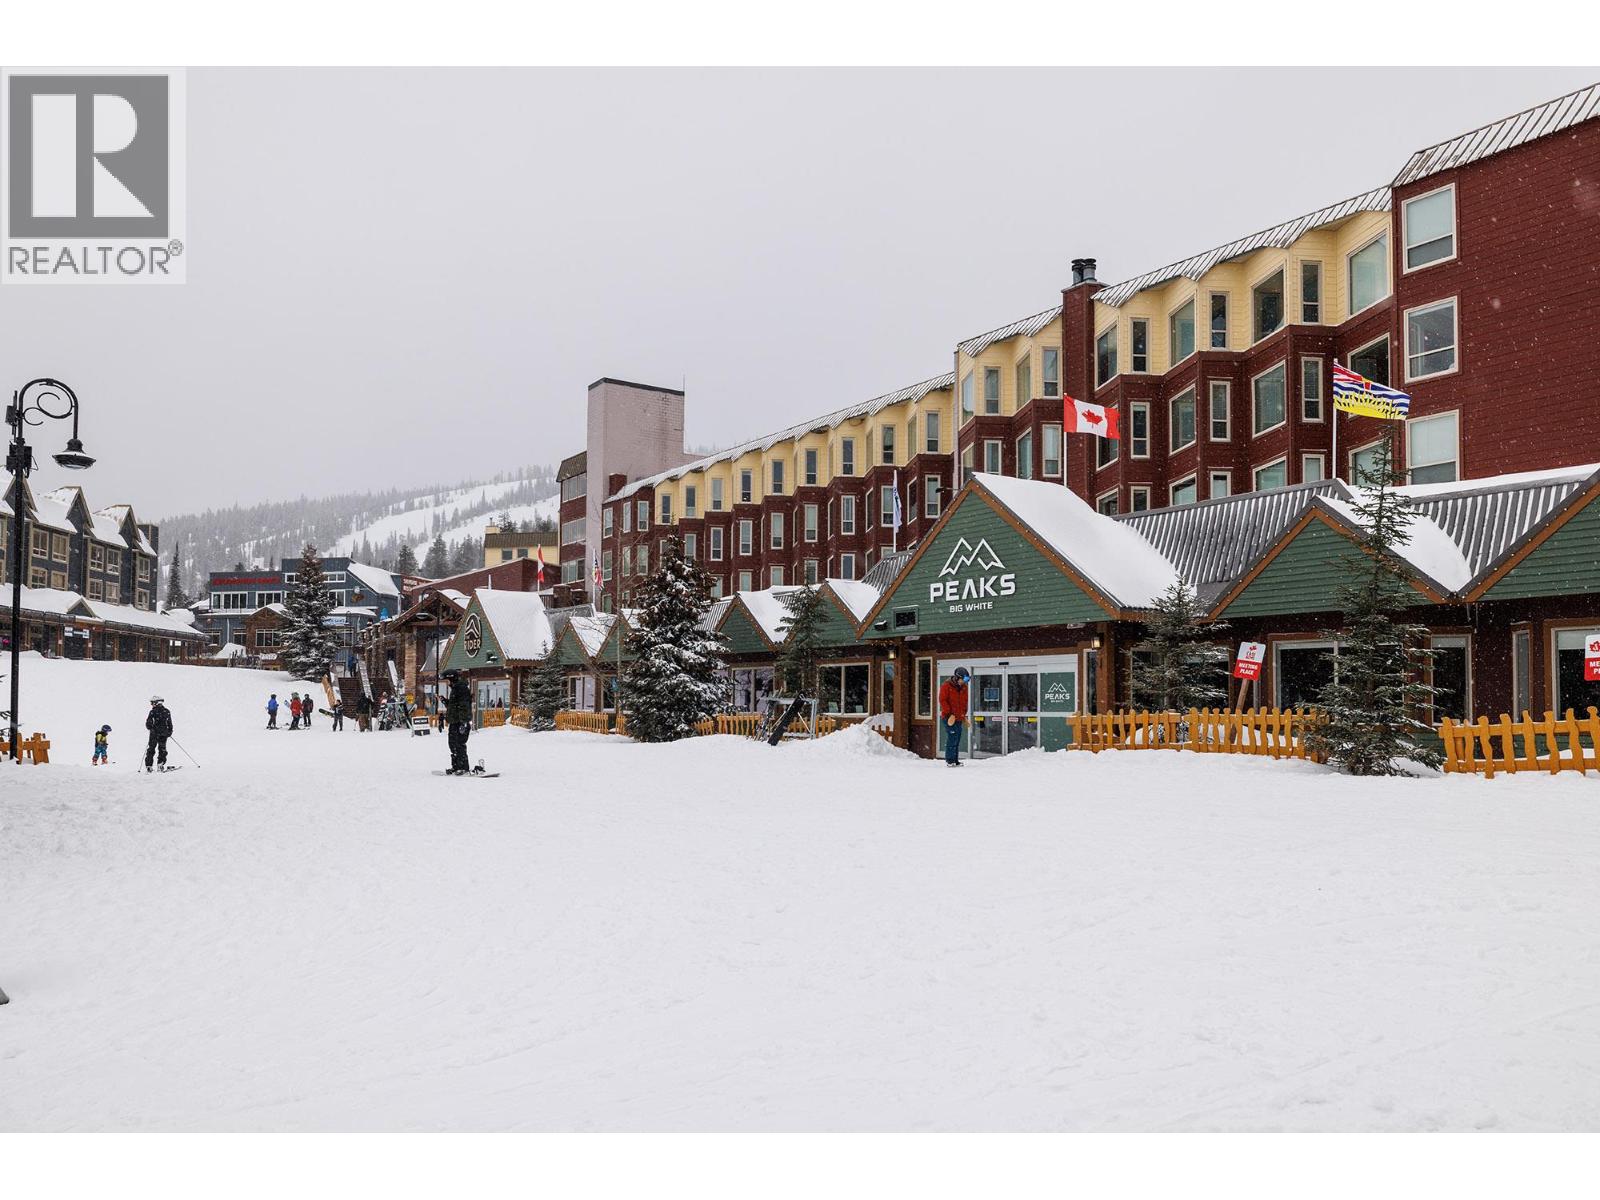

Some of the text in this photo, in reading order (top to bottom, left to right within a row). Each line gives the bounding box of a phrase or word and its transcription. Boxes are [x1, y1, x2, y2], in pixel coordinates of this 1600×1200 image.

[930, 573, 1016, 603] PEAKS
[949, 601, 993, 613] BIG WHITE
[464, 639, 480, 650] RIDER
